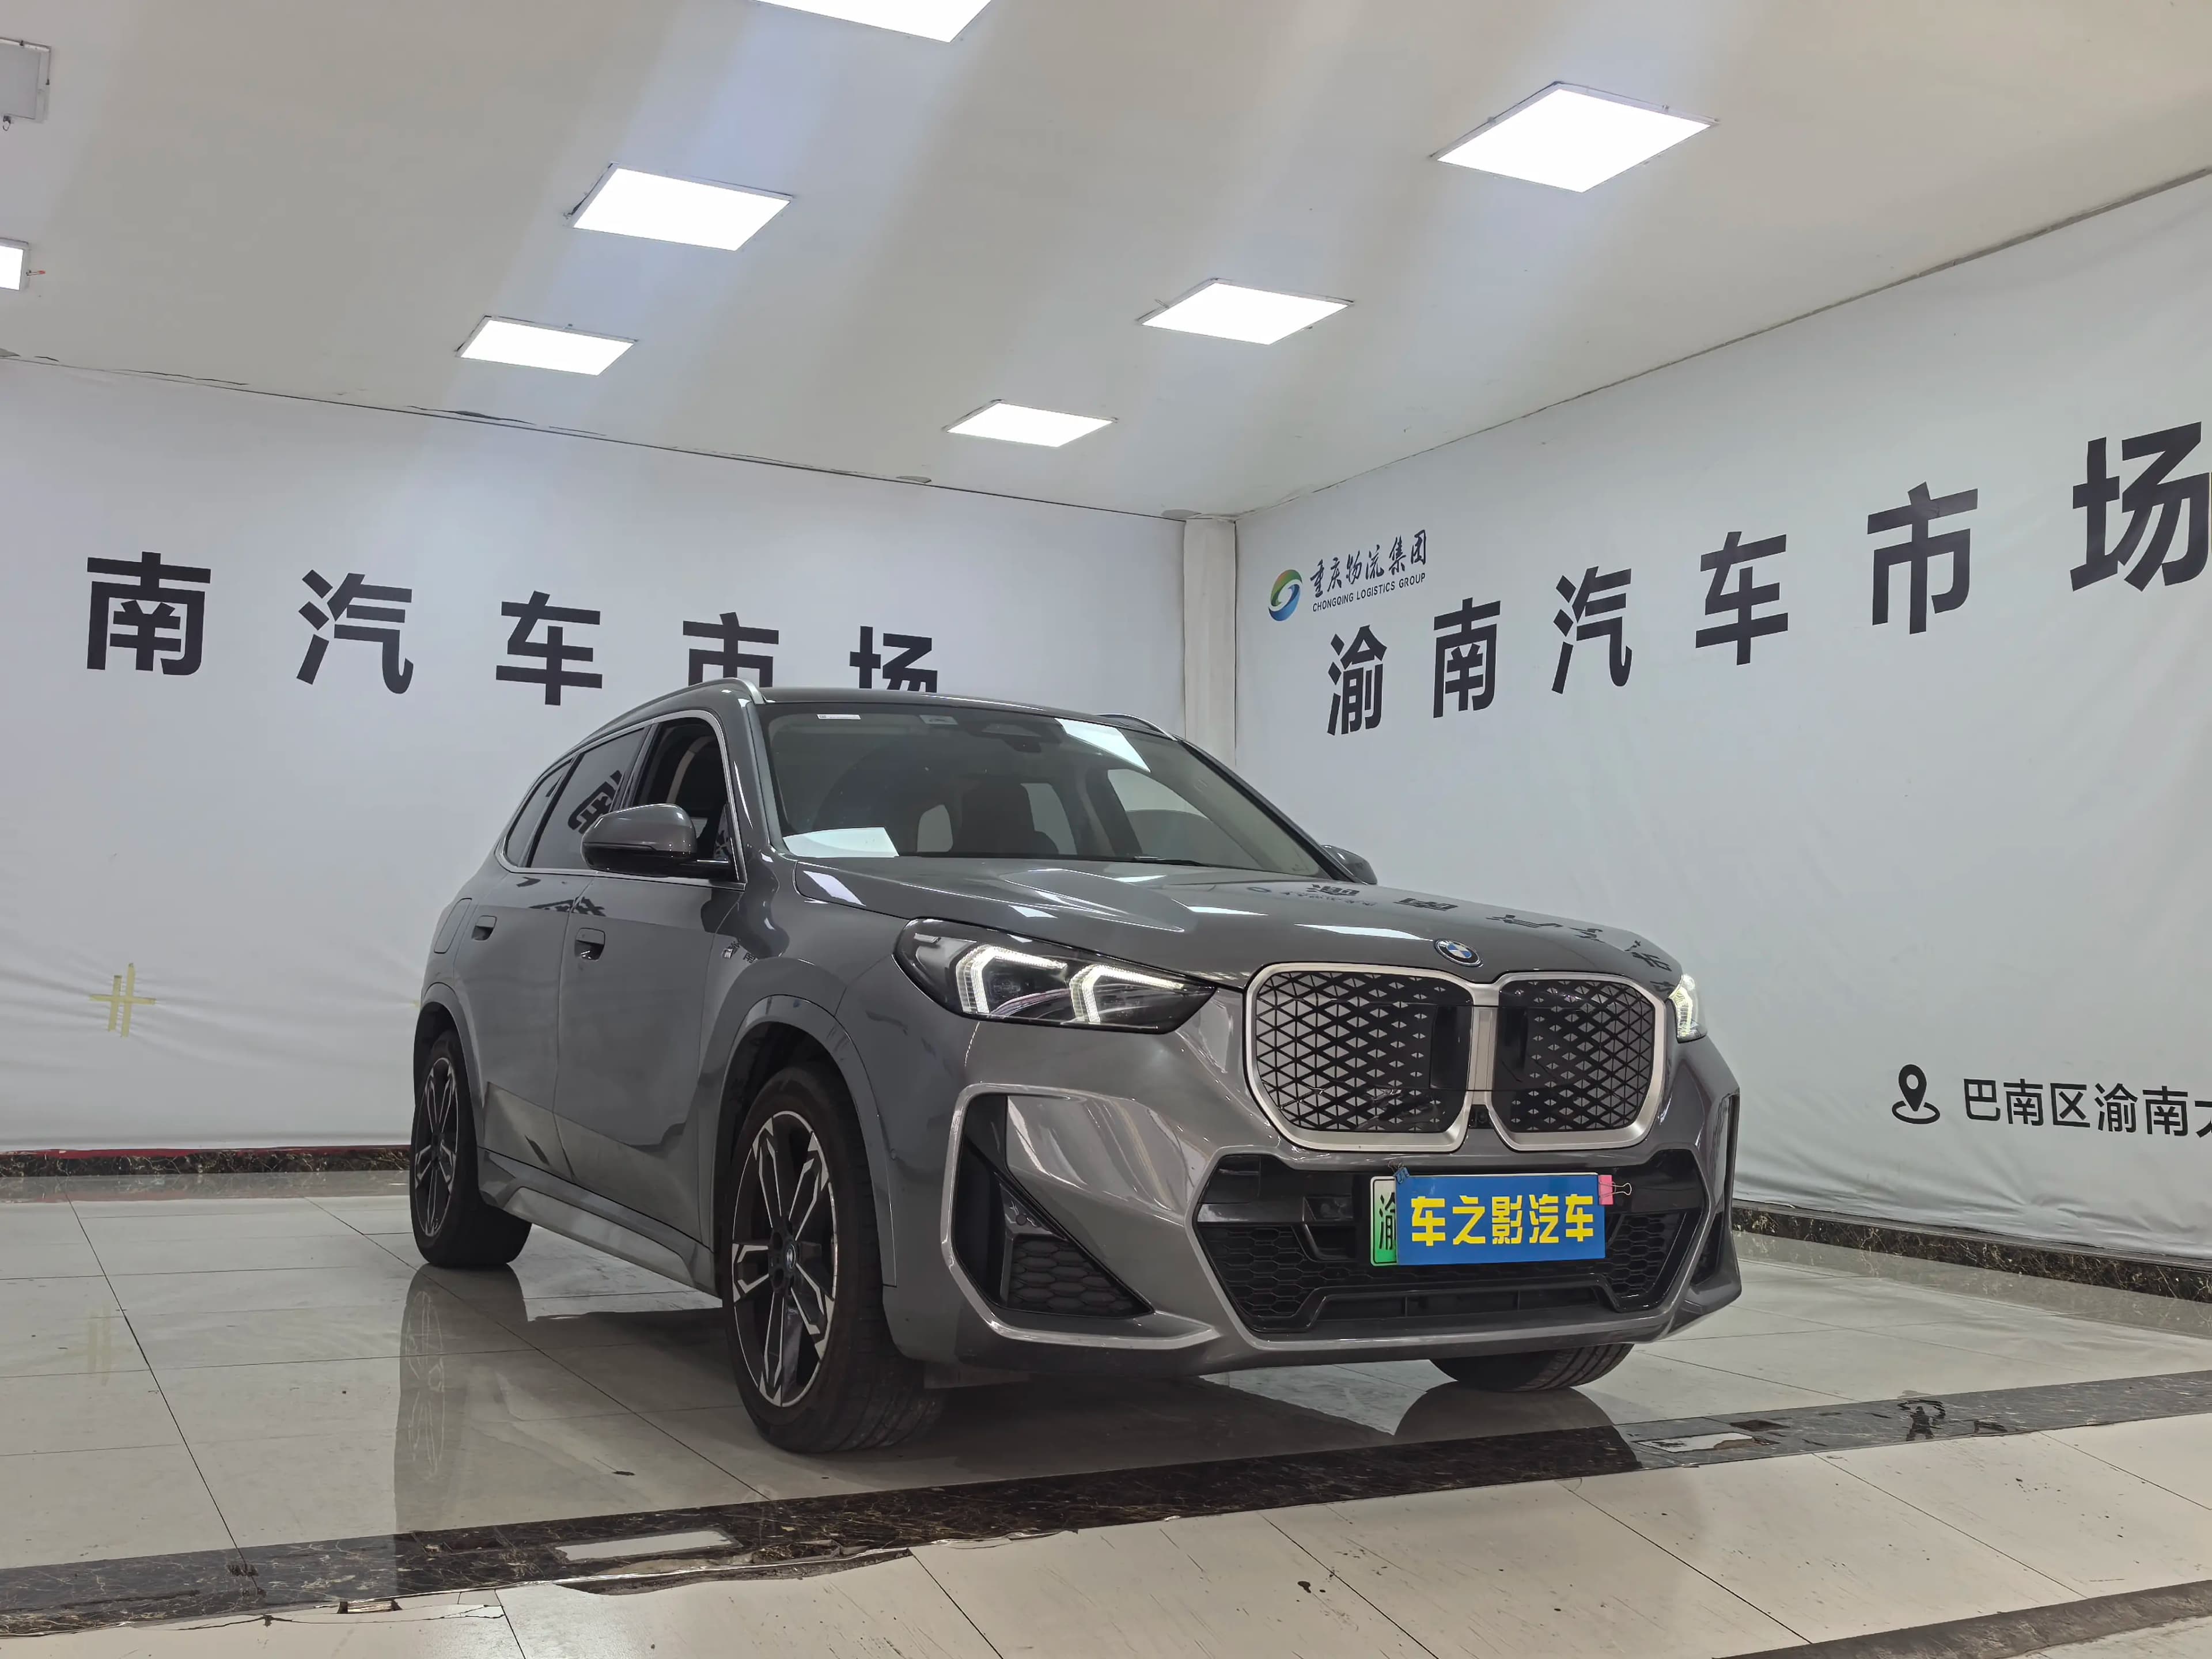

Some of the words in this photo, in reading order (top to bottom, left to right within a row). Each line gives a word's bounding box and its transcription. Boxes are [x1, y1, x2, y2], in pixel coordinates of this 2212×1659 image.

[1310, 529, 1426, 598] 重庆物流集团
[1313, 593, 1354, 612] CHONGQING
[1357, 581, 1395, 600] LOGISTICS
[1399, 573, 1426, 588] GROUP
[1327, 421, 2210, 736] 渝南汽车市场
[1411, 1194, 1594, 1247] 车之影汽车
